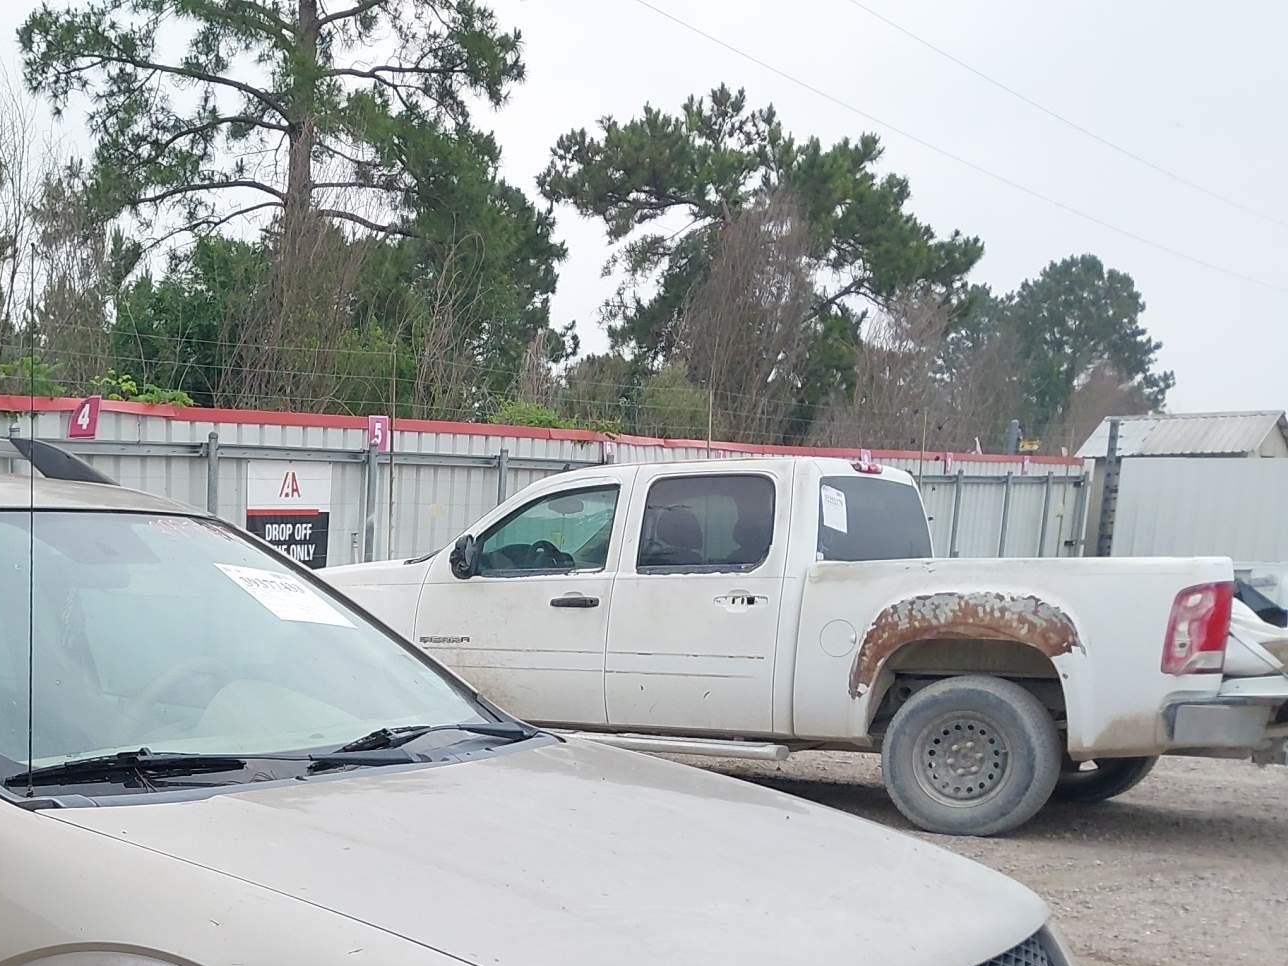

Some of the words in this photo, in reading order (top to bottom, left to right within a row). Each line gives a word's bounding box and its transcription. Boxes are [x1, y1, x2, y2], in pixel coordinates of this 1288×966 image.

[77, 403, 90, 430] 4
[372, 422, 382, 444] 5
[265, 523, 293, 541] DROP
[295, 523, 312, 541] OFF
[290, 544, 315, 561] ONLY
